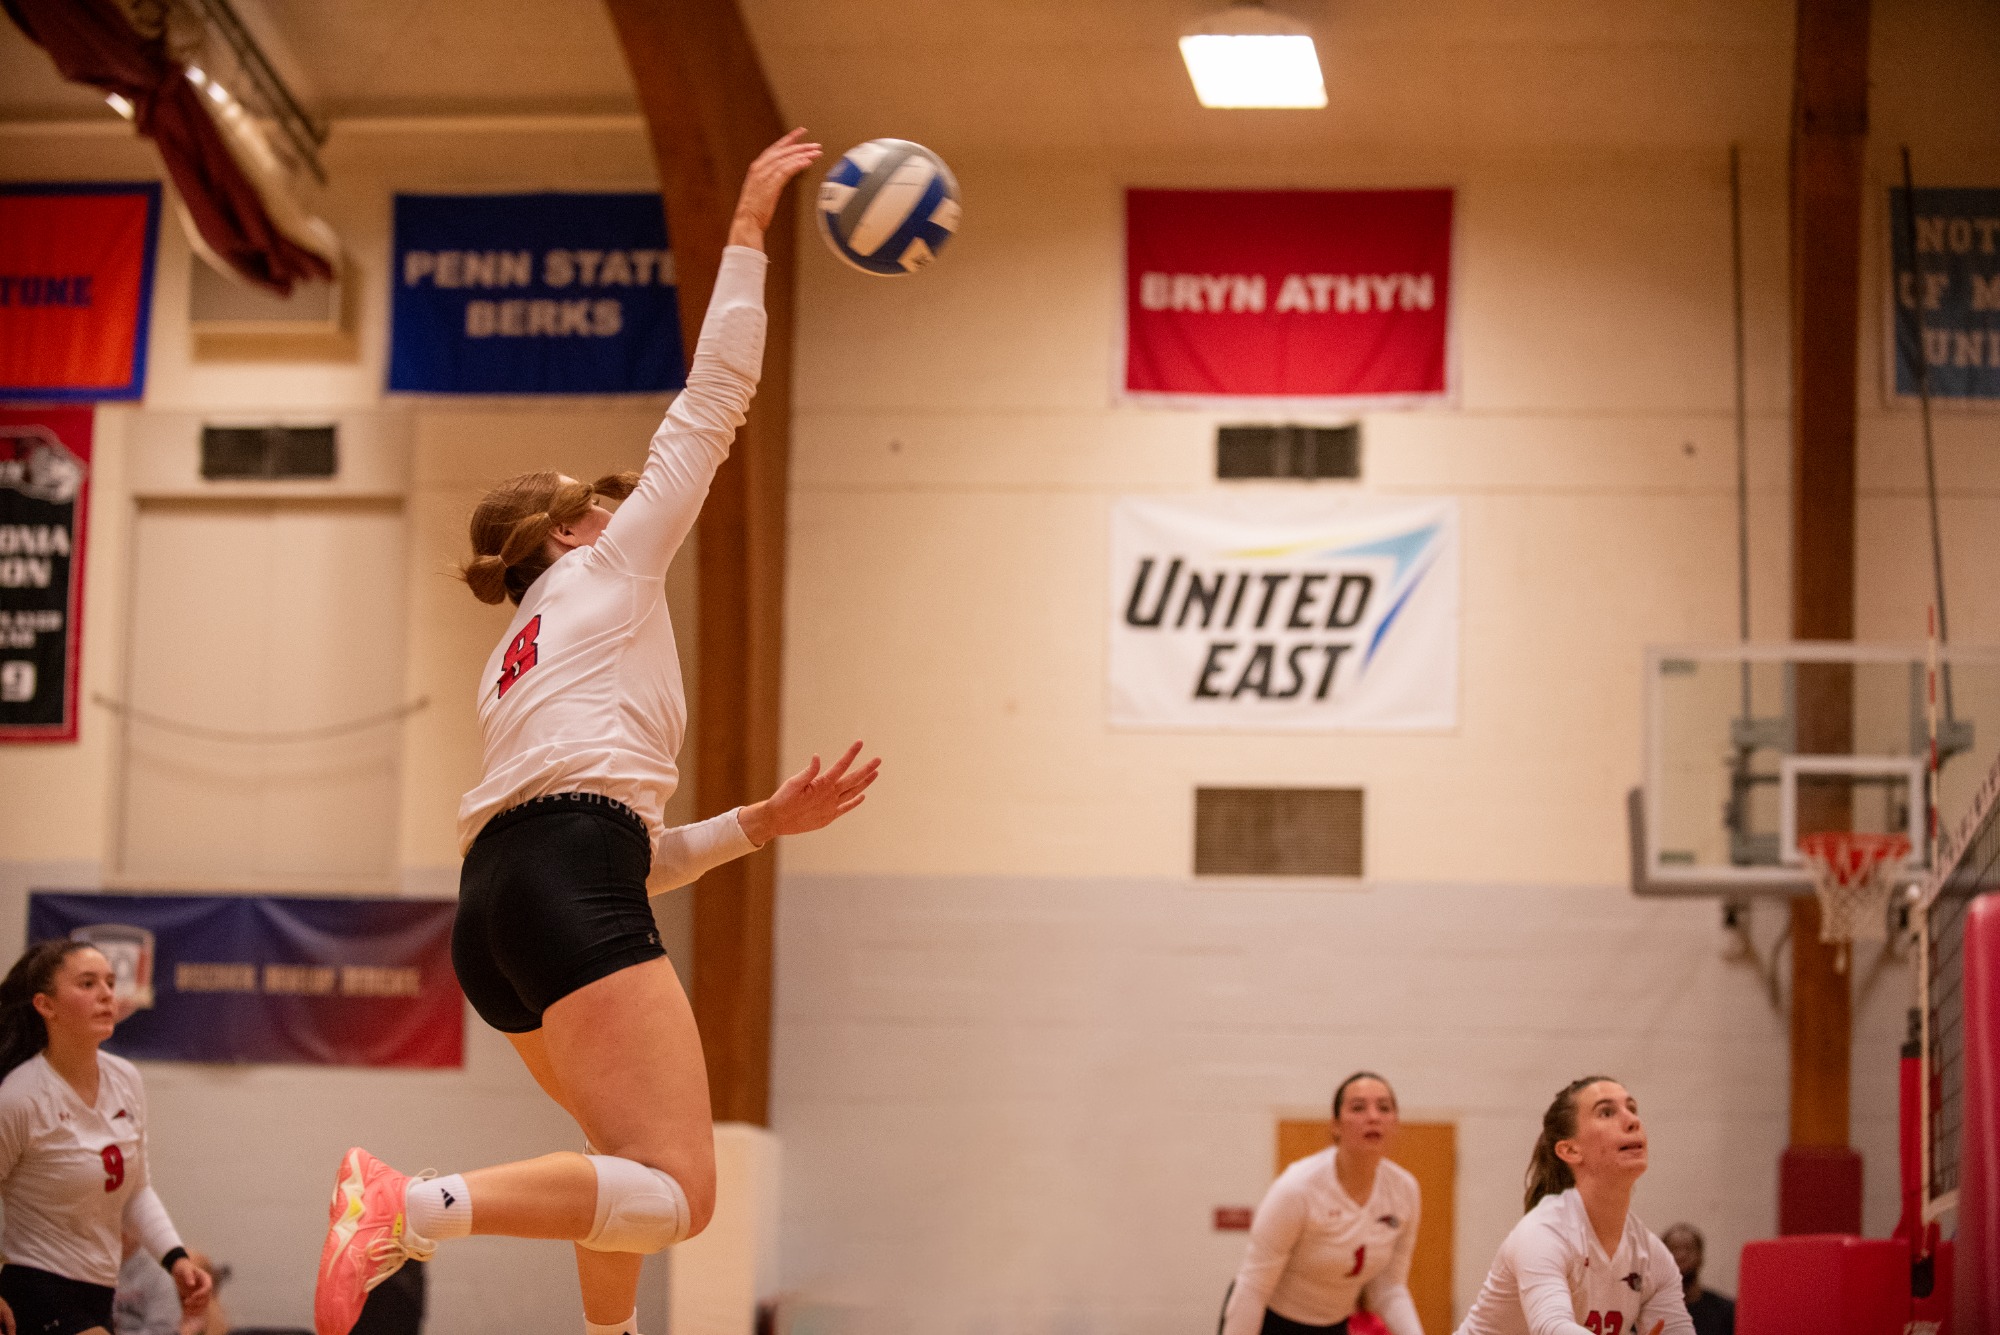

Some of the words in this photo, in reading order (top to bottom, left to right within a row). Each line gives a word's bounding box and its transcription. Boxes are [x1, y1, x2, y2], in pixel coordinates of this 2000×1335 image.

[404, 251, 532, 288] PENN
[1140, 272, 1267, 313] BRYN
[1275, 273, 1435, 313] ATHYN
[464, 299, 623, 338] BERKS
[1125, 557, 1375, 630] UNITED
[1193, 643, 1355, 702] EAST
[101, 1144, 125, 1193] 9
[1343, 1244, 1366, 1278] 1
